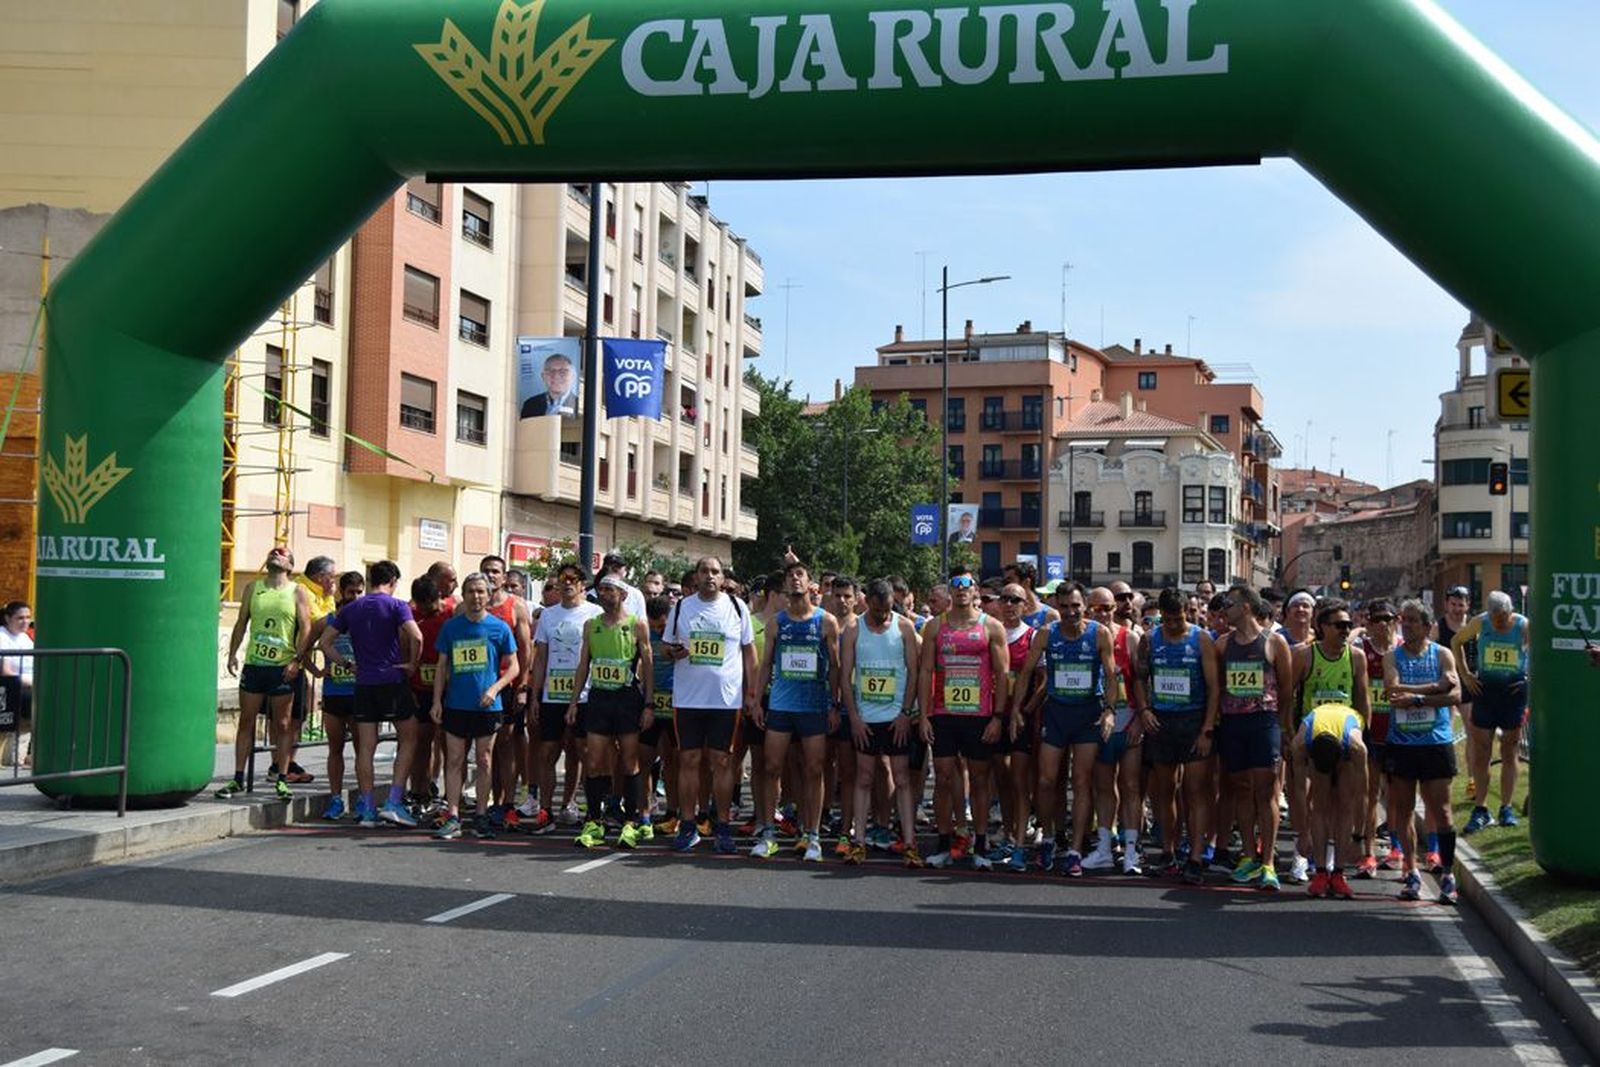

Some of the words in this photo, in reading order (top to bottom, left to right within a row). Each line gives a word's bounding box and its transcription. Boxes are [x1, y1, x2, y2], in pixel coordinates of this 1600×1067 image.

[621, 14, 857, 98] CAJA
[868, 0, 1229, 88] RURAL
[614, 358, 654, 371] VOTA
[60, 536, 165, 562] RURAL
[255, 643, 277, 659] 136
[461, 648, 478, 662] 18
[694, 641, 719, 655] 150
[1494, 651, 1509, 663] 91
[596, 667, 620, 681] 104
[1231, 672, 1257, 686] 124
[553, 678, 574, 691] 114
[868, 678, 886, 692] 67
[952, 687, 970, 702] 20
